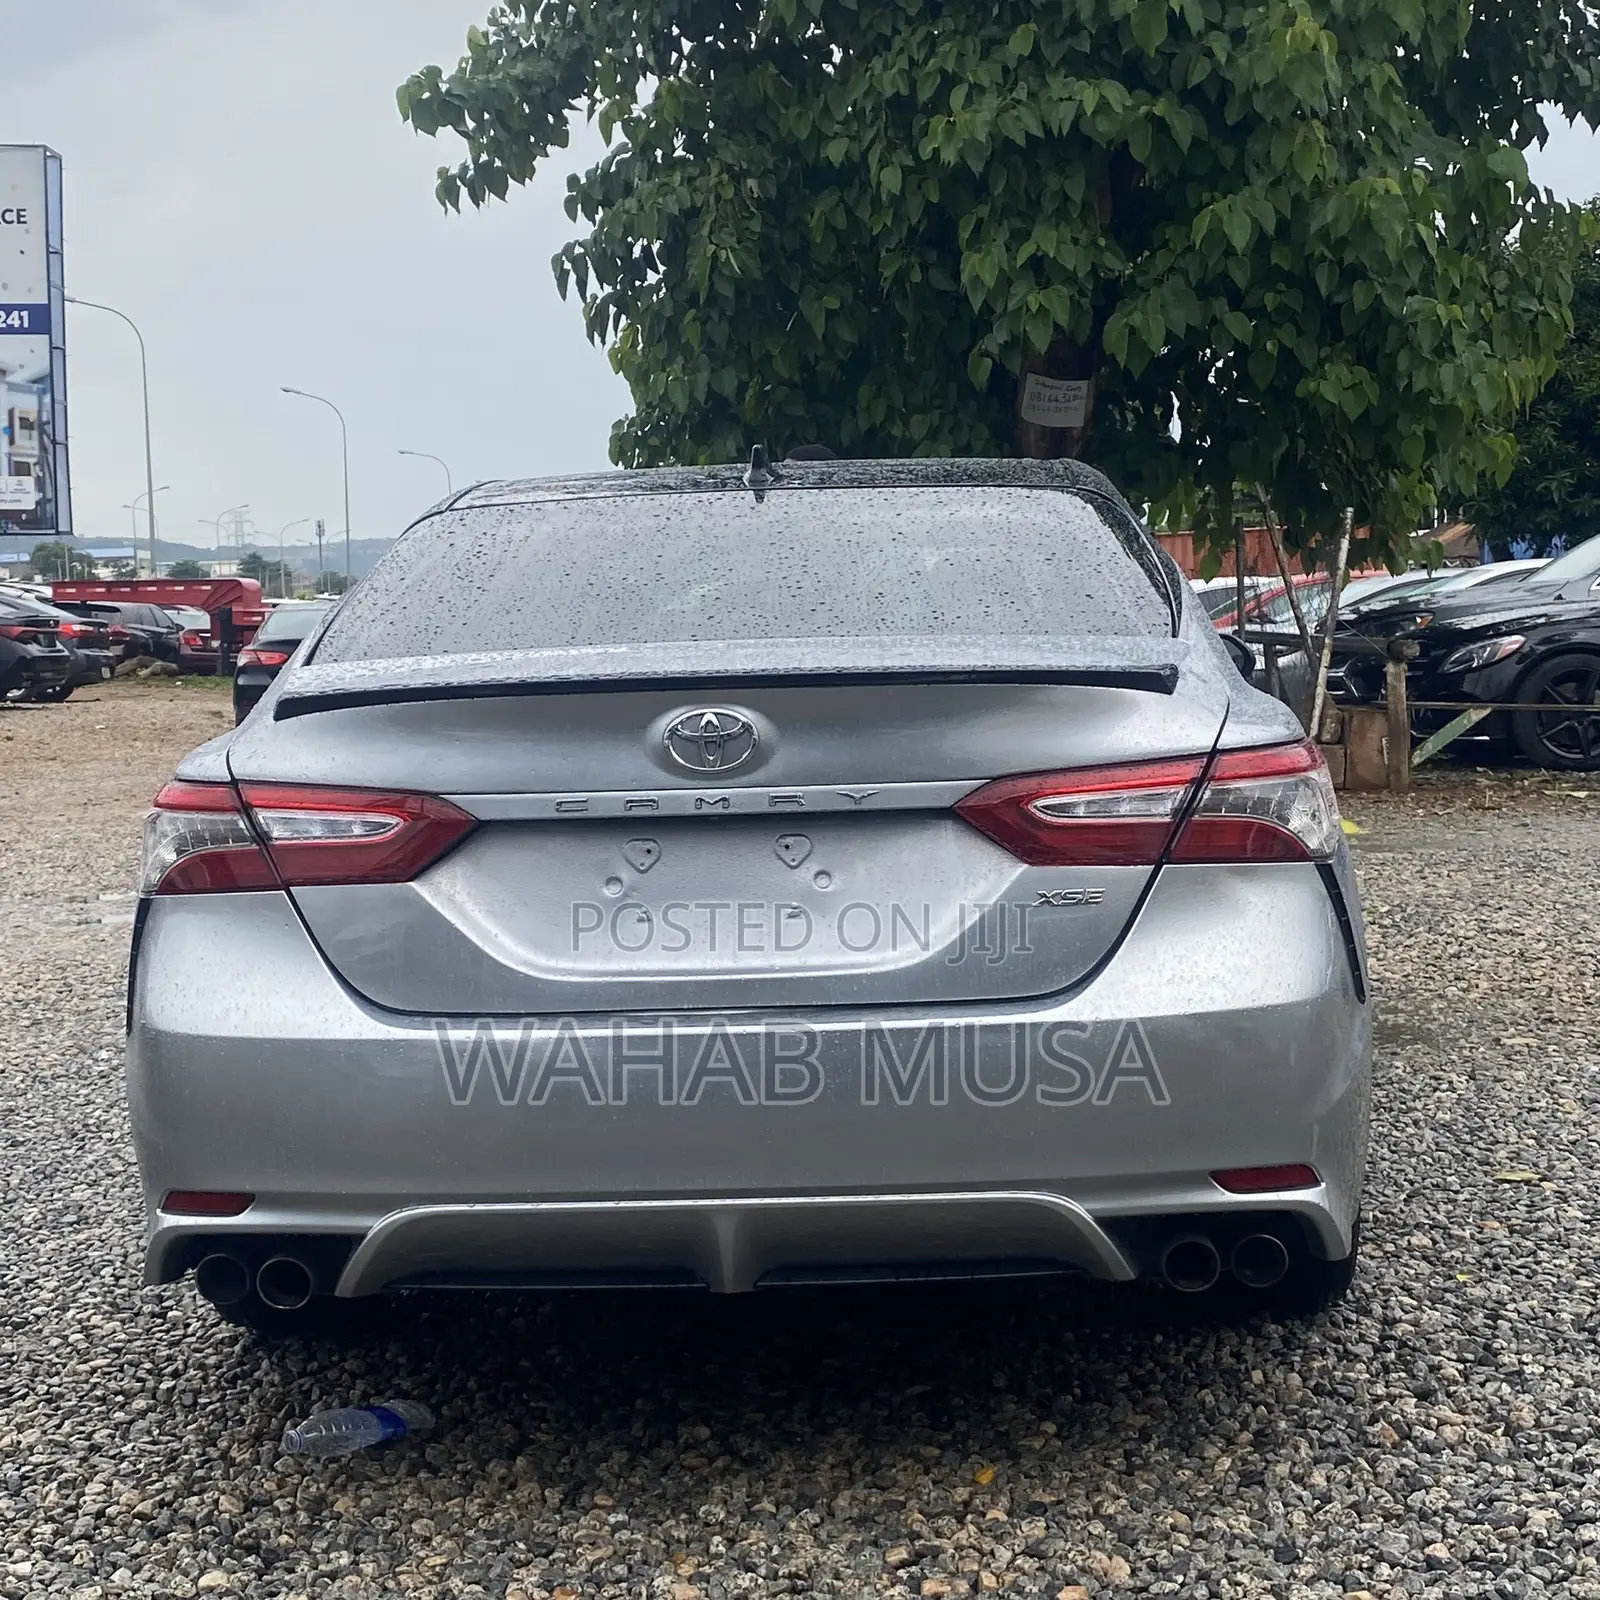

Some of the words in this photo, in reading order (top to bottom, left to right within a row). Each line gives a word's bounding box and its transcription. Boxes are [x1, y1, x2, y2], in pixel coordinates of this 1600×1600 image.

[0, 208, 27, 224] CE
[555, 789, 880, 813] CAMRY
[1032, 887, 1106, 907] XSE
